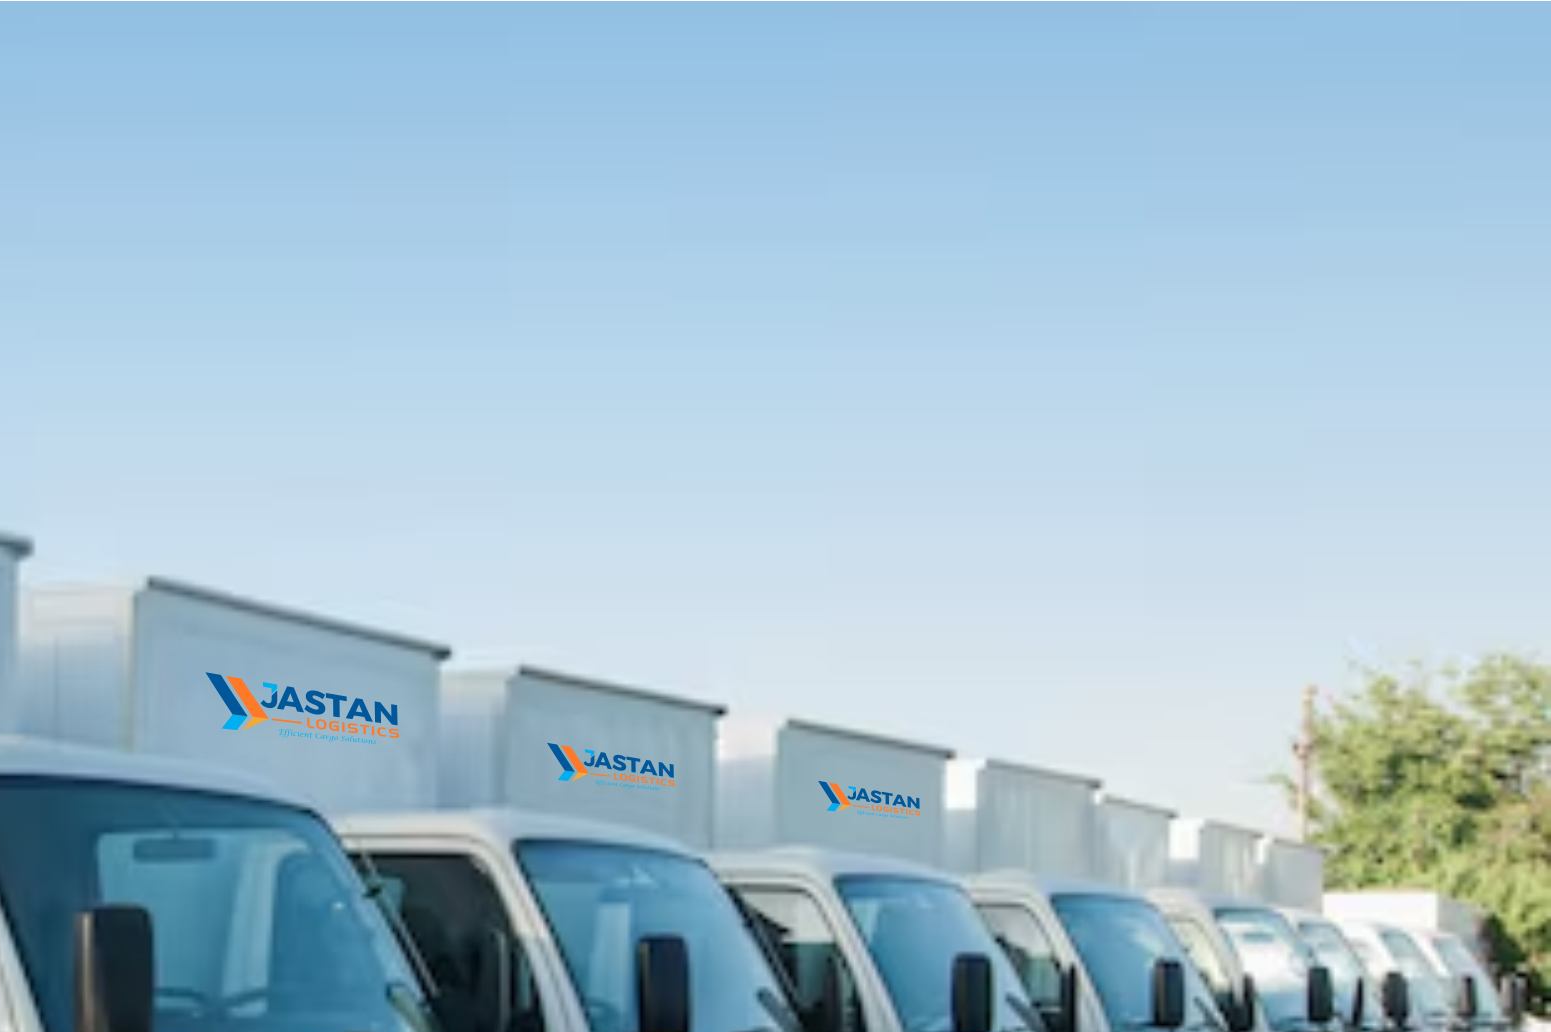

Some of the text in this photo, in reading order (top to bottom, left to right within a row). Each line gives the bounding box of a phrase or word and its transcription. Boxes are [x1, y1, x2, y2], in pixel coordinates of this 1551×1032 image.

[260, 682, 398, 726] JASTAN
[278, 729, 377, 745] Efficient Cargo Solutions
[306, 717, 400, 739] LOGISTICS
[583, 749, 675, 778] JASTAN
[613, 772, 676, 787] LOGISTICS
[847, 786, 920, 809] JASTAN
[871, 804, 921, 816] LOGISTICS
